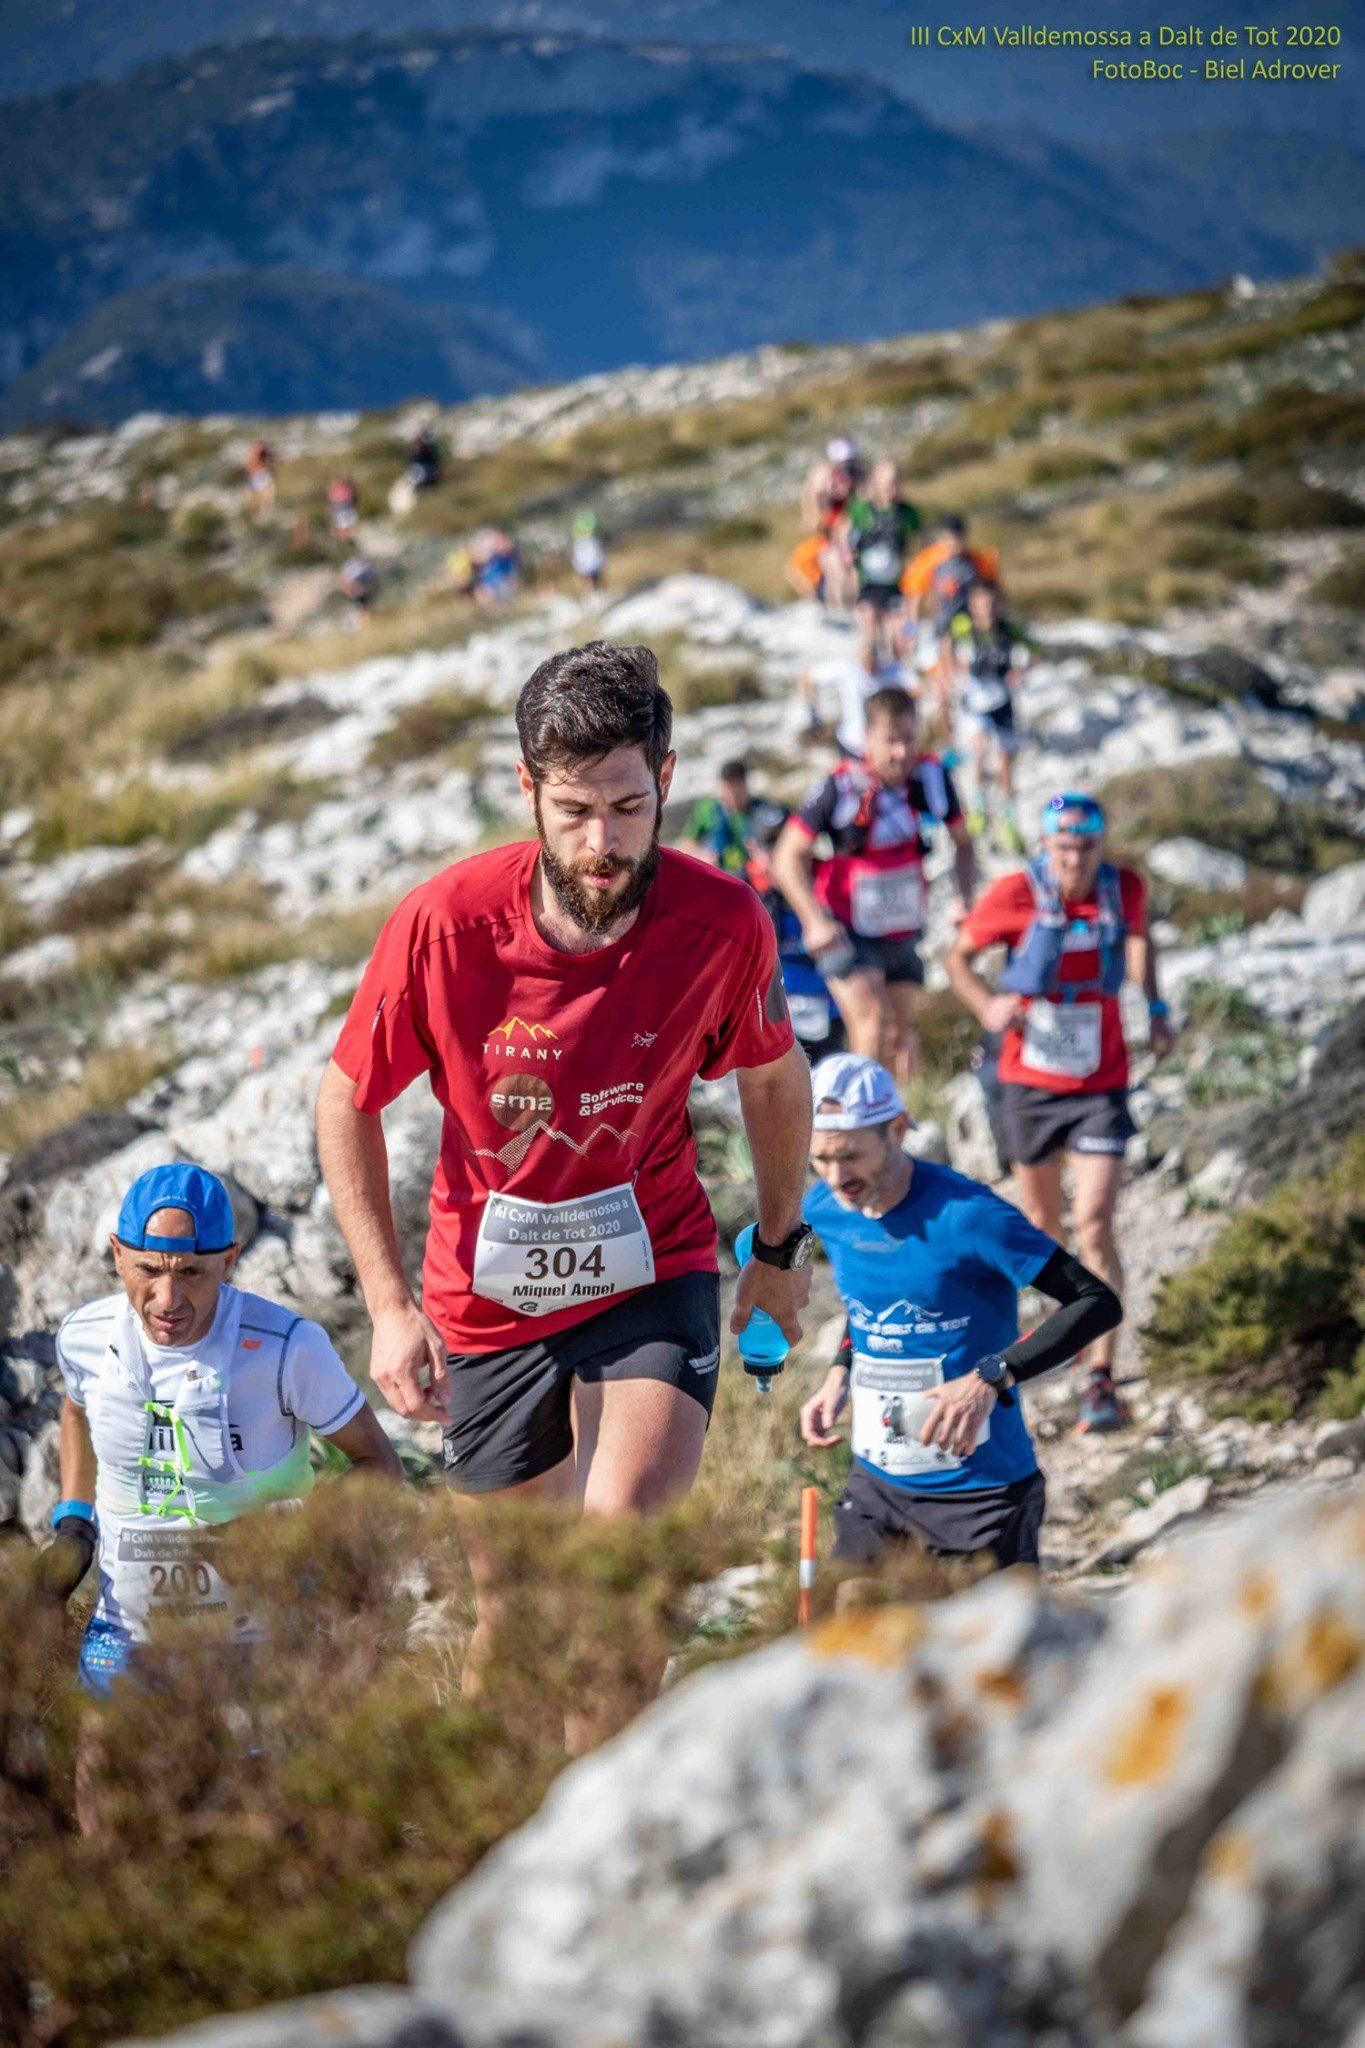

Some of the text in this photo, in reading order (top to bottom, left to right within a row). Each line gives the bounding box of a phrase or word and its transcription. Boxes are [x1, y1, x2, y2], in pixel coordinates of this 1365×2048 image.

[481, 1042, 563, 1061] TIRANY
[491, 1093, 552, 1111] sma
[580, 1082, 644, 1104] Software
[508, 1208, 539, 1225] CxM
[542, 1202, 621, 1225] Valldemossa
[508, 1219, 621, 1241] Dalt de Tot 2020
[524, 1244, 606, 1280] 304
[571, 1283, 615, 1297] Angel
[150, 1564, 211, 1597] 200
